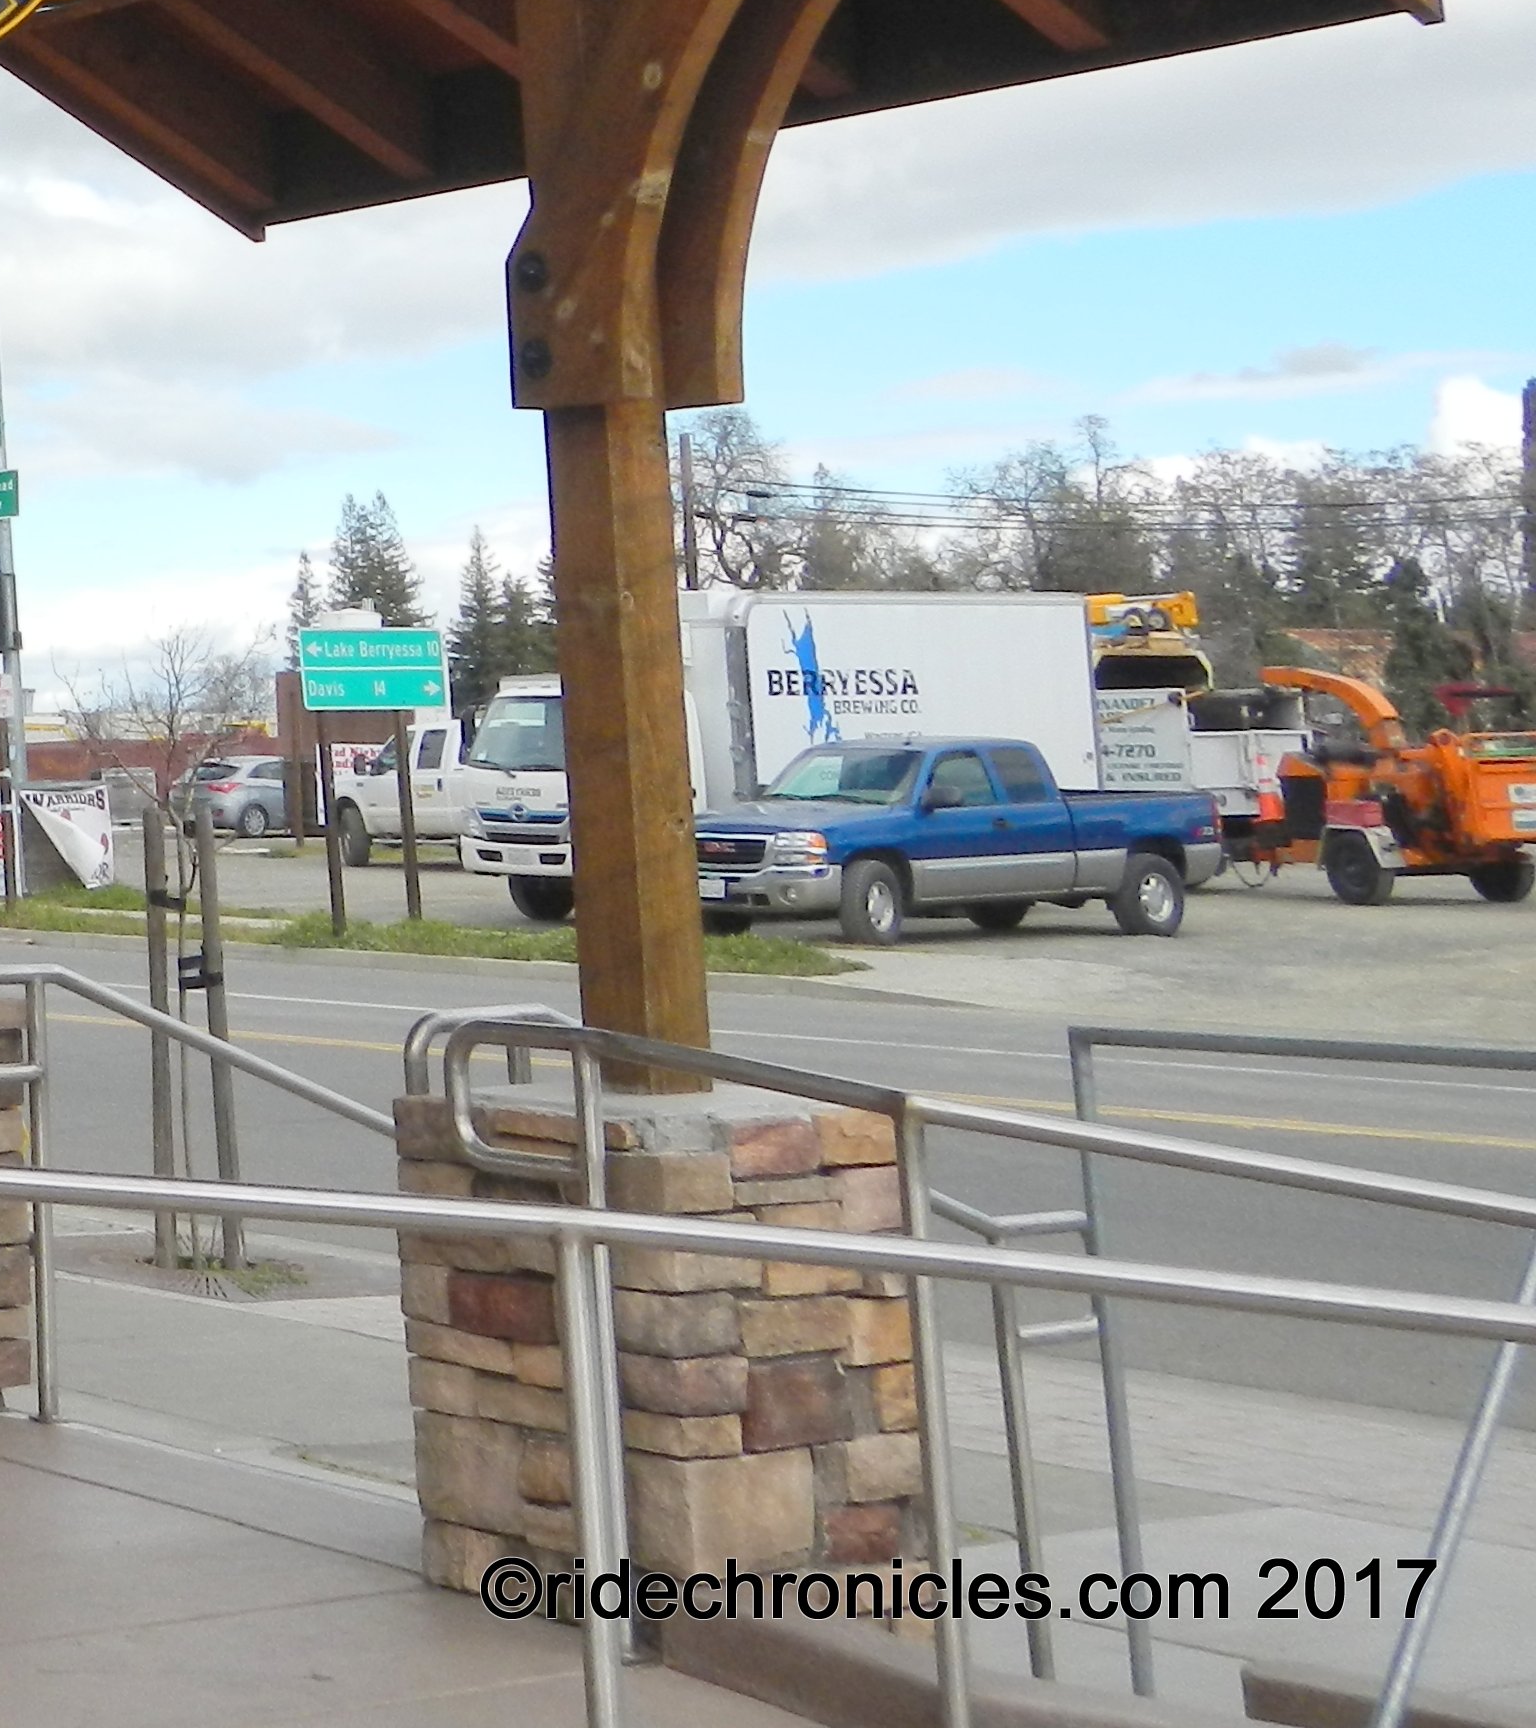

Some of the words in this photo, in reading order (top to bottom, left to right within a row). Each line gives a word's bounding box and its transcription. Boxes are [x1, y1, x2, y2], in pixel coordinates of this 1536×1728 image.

[324, 640, 355, 657] Lake
[359, 640, 423, 660] Berryessa
[426, 641, 440, 657] 10
[308, 679, 345, 697] Davis
[373, 680, 387, 697] 14
[766, 668, 920, 697] BERRYESSA
[833, 699, 898, 715] BREWING
[25, 789, 106, 811] WARRIORS
